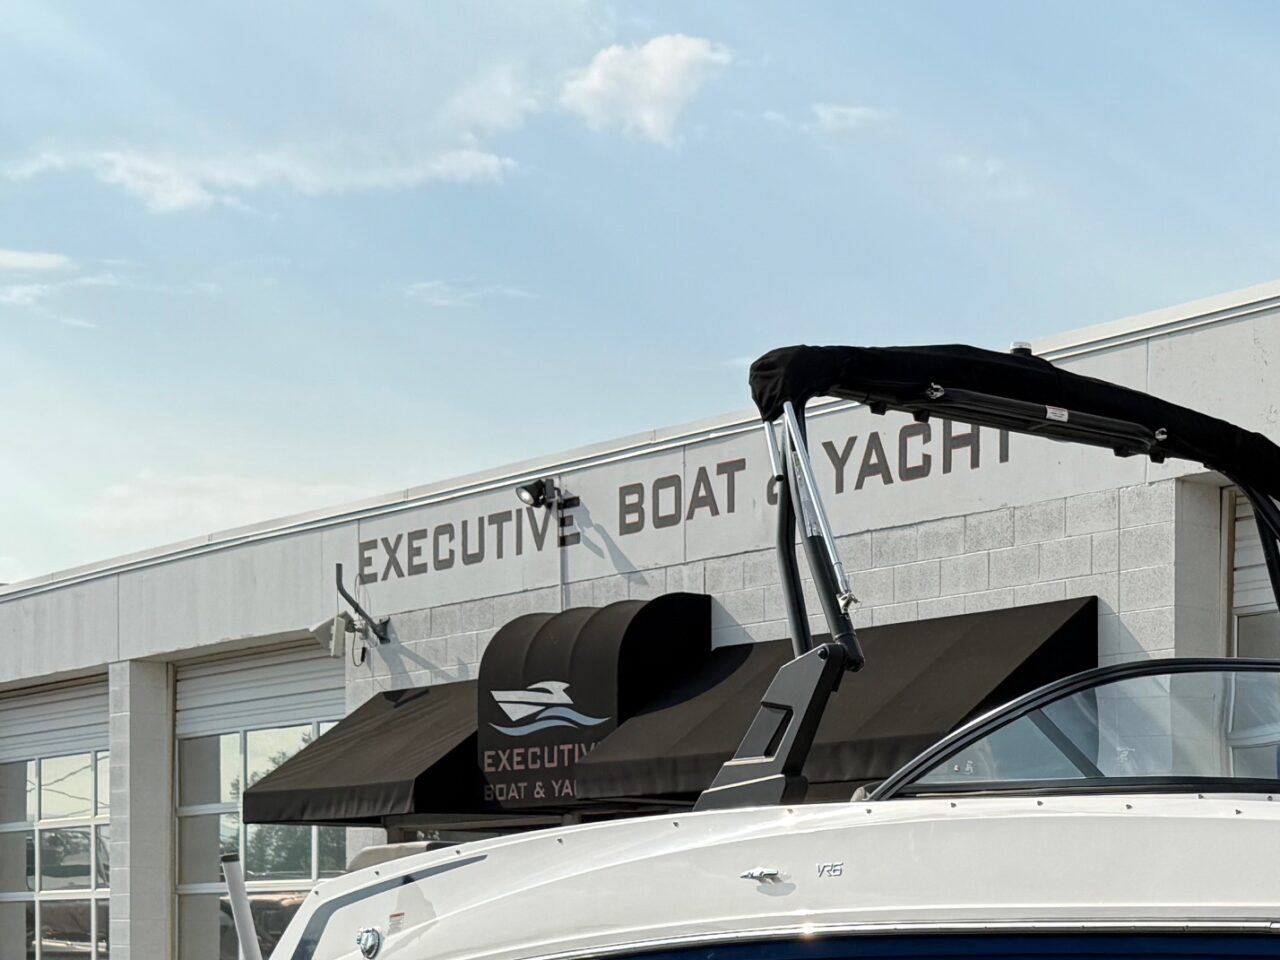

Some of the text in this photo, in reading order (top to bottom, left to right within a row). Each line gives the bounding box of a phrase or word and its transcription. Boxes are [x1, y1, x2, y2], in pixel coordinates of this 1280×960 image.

[359, 496, 580, 585] EXECUTIVE
[619, 458, 746, 536] BOAT
[484, 742, 600, 772] EXECUTIV
[484, 779, 577, 801] BOAT & YA
